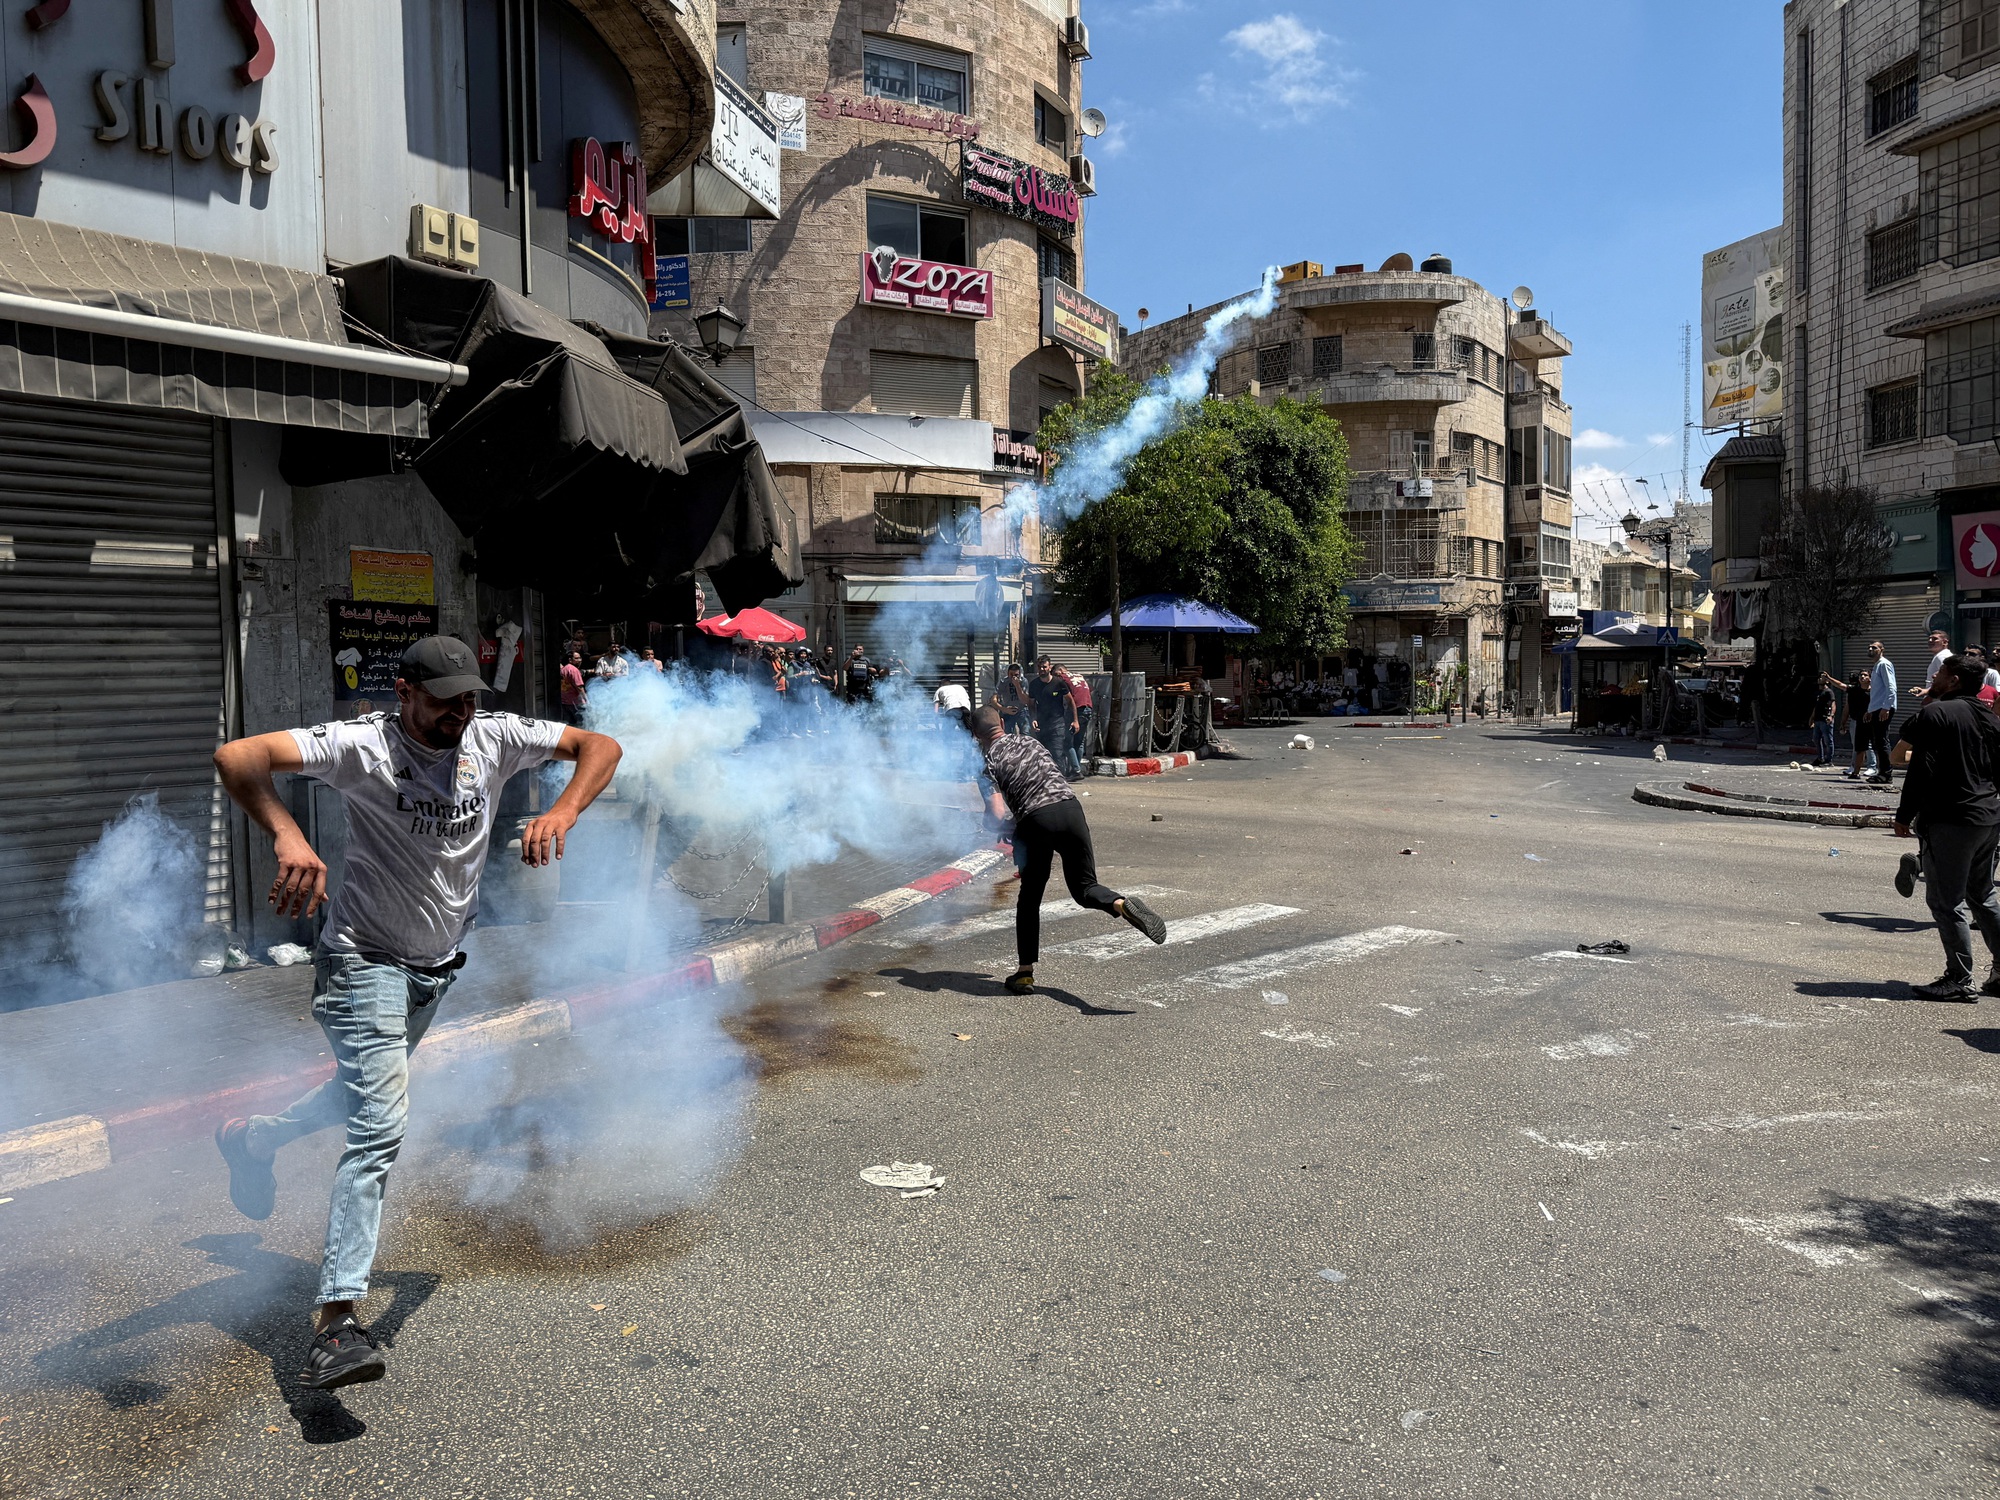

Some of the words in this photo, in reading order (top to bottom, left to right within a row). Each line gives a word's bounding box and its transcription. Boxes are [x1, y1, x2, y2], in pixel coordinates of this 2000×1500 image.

[715, 73, 731, 95] عثمان
[731, 91, 747, 109] شريف
[815, 92, 837, 119] 3
[96, 69, 280, 174] Shoes
[746, 107, 763, 127] المحامي
[763, 120, 776, 137] مكتب
[712, 138, 738, 172] عثمان
[749, 143, 776, 169] المحامي
[965, 149, 1013, 184] Fustan
[738, 160, 760, 191] شريف
[969, 179, 1013, 204] Boutique
[1014, 165, 1079, 223] فستان
[666, 261, 687, 272] الدكتور
[895, 261, 988, 295] ZOYA
[1721, 295, 1749, 320] gate
[339, 605, 372, 620] الساعة
[374, 609, 406, 625] ومطبخ
[407, 611, 431, 628] مطعم
[361, 628, 383, 642] اليومية
[384, 631, 407, 643] الوجبات
[409, 632, 418, 643] لكم
[1555, 624, 1578, 634] الشعب
[368, 648, 382, 658] قدرة
[368, 661, 388, 669] محشي
[388, 662, 400, 671] جاج
[361, 671, 382, 682] ملوخية
[380, 683, 394, 691] سمك
[411, 816, 432, 835] FLY
